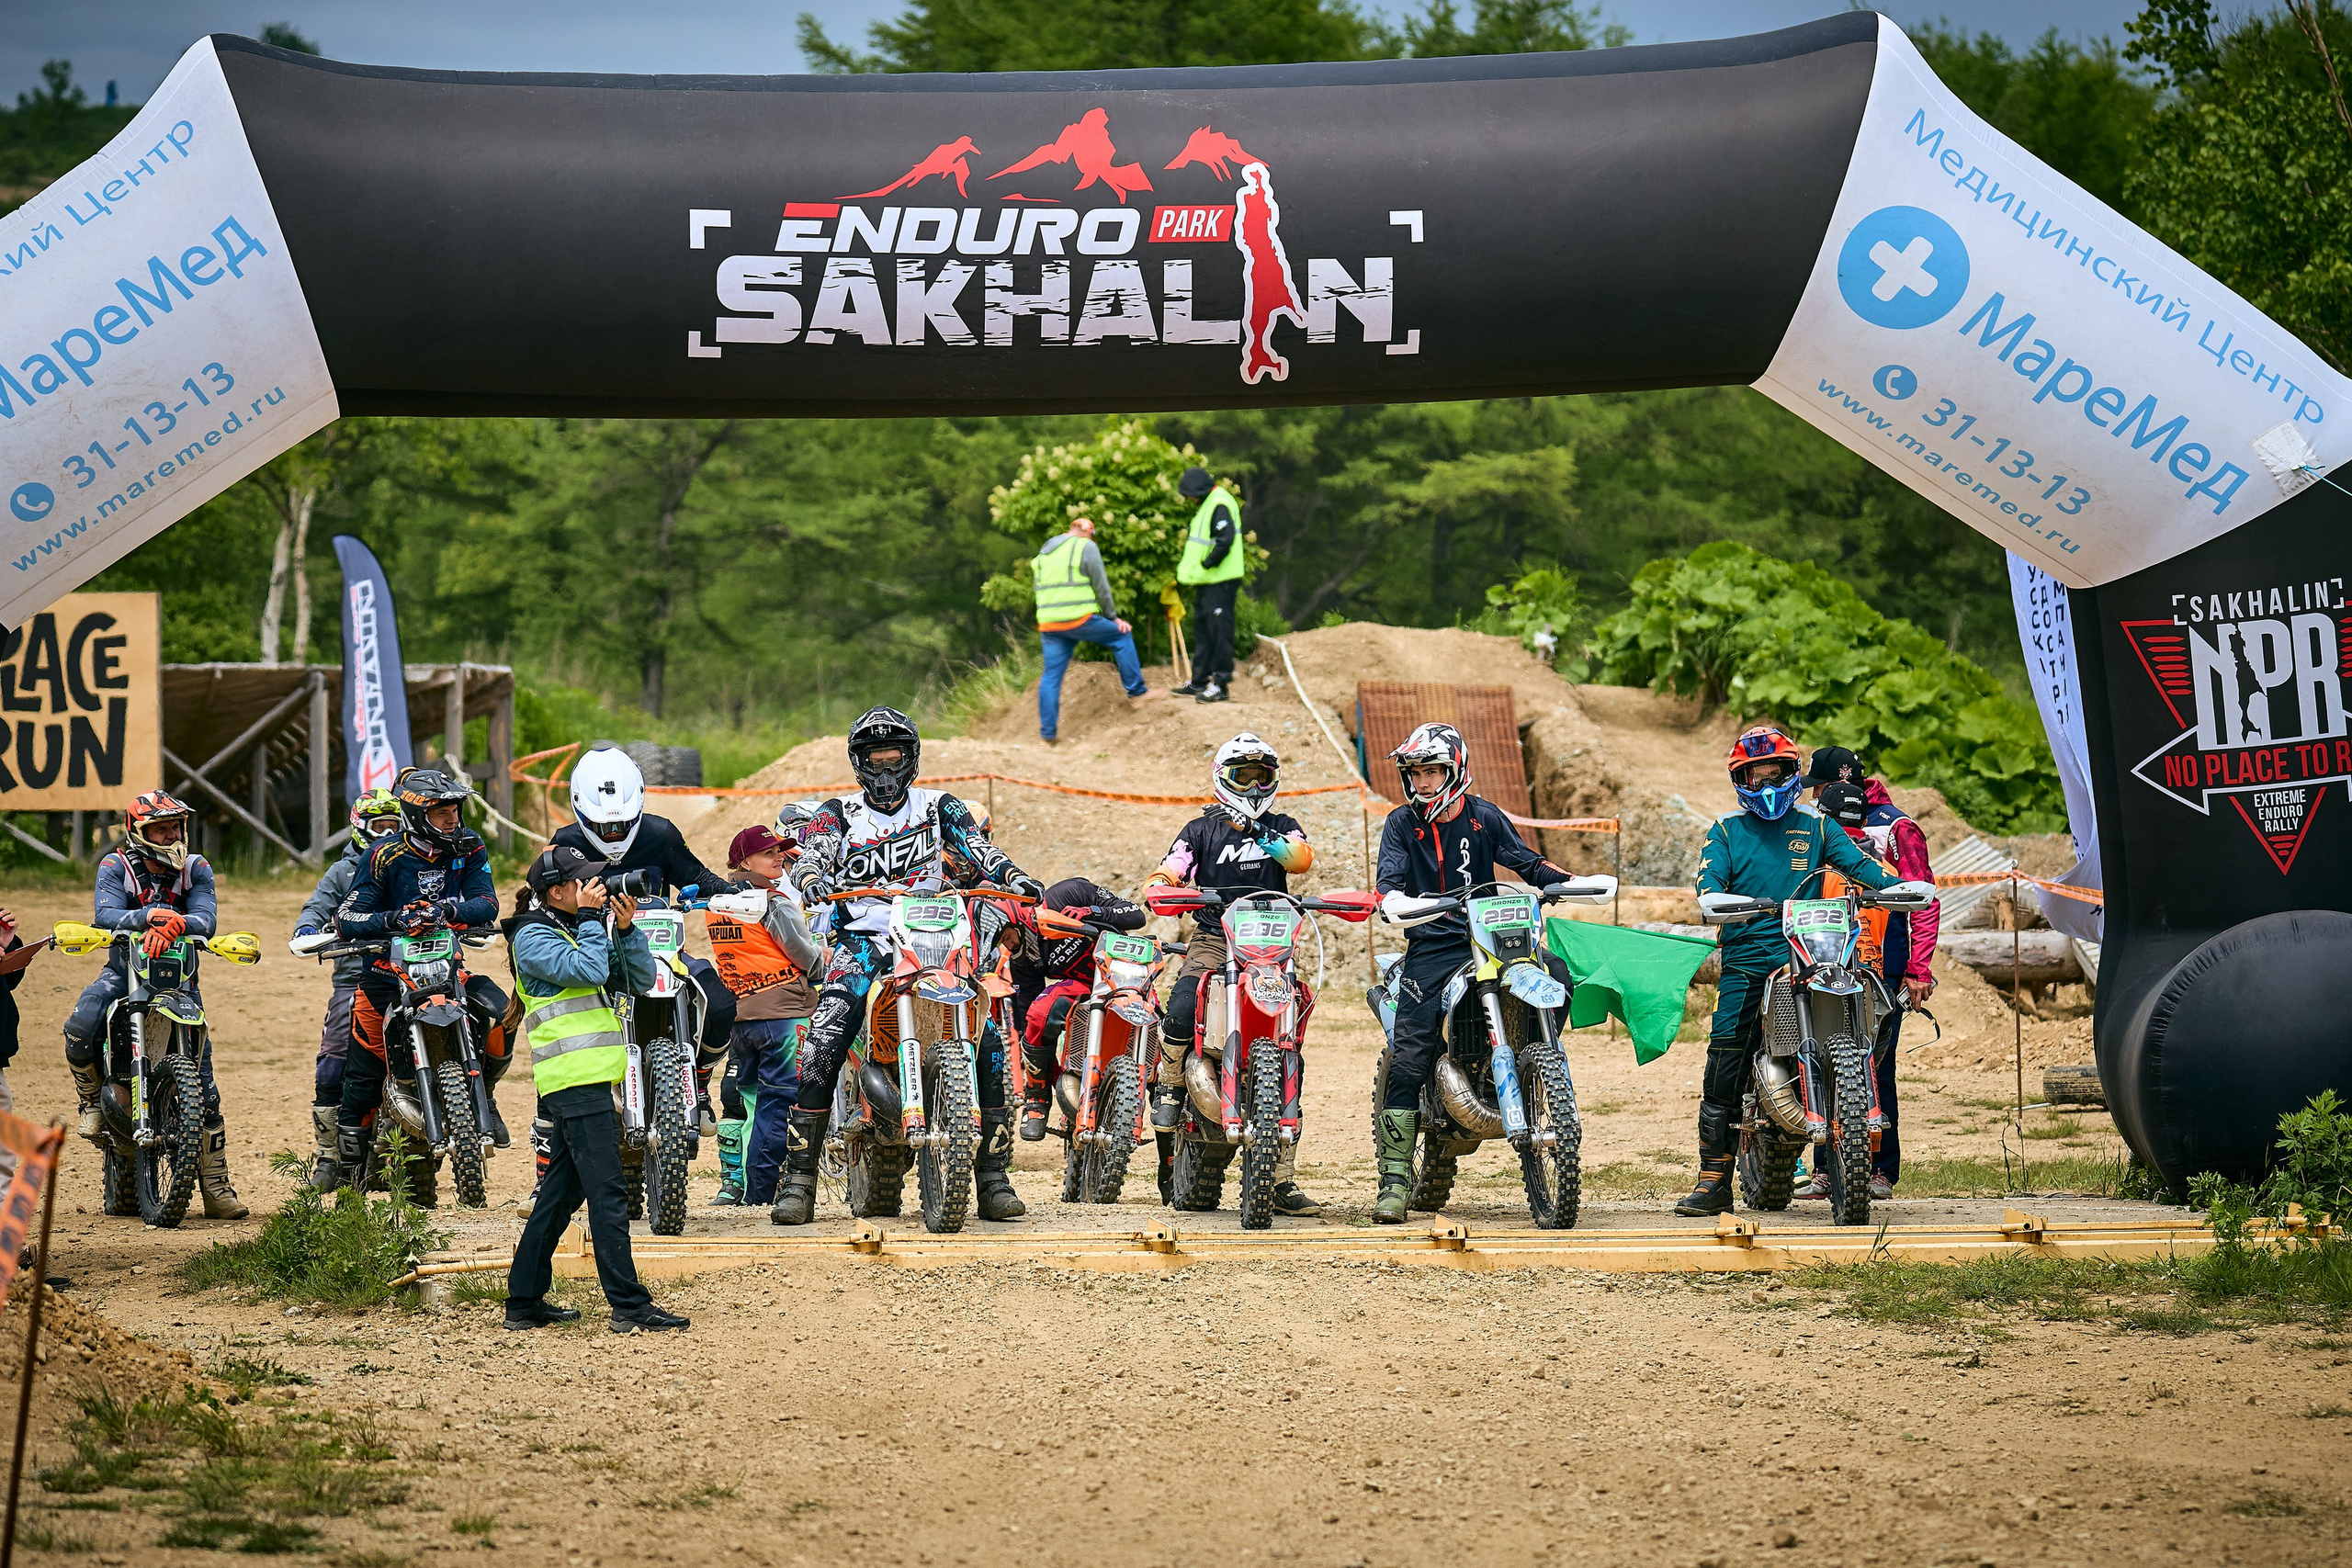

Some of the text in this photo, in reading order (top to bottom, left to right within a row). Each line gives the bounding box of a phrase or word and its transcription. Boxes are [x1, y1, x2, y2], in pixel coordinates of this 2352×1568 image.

[0, 119, 194, 276] ий Центр
[775, 203, 1220, 254] ENDURO PARK
[1904, 107, 2324, 425] Медицинский Центр
[1958, 291, 2250, 516] МареМед
[62, 362, 235, 489] 31-13-13
[1817, 378, 2081, 555] www.maremed.ru
[1921, 397, 2092, 516] 31-13-13
[11, 384, 286, 572] www.maremed.ru
[2189, 581, 2329, 622] SAKHALIN
[2188, 613, 2347, 750] NPR
[2165, 754, 2199, 787] NO
[2205, 747, 2290, 785] PLACE
[2295, 743, 2329, 776] TO
[2254, 789, 2307, 807] EXTREME
[2258, 804, 2303, 820] ENDURO
[2265, 817, 2299, 832] RALLY
[906, 904, 956, 922] 292
[1237, 921, 1288, 938] 206
[1484, 907, 1531, 927] 250
[1796, 908, 1845, 927] 222
[406, 939, 450, 957] 295
[640, 928, 673, 944] 72
[1113, 940, 1146, 956] 211
[908, 1043, 917, 1091] METZELER
